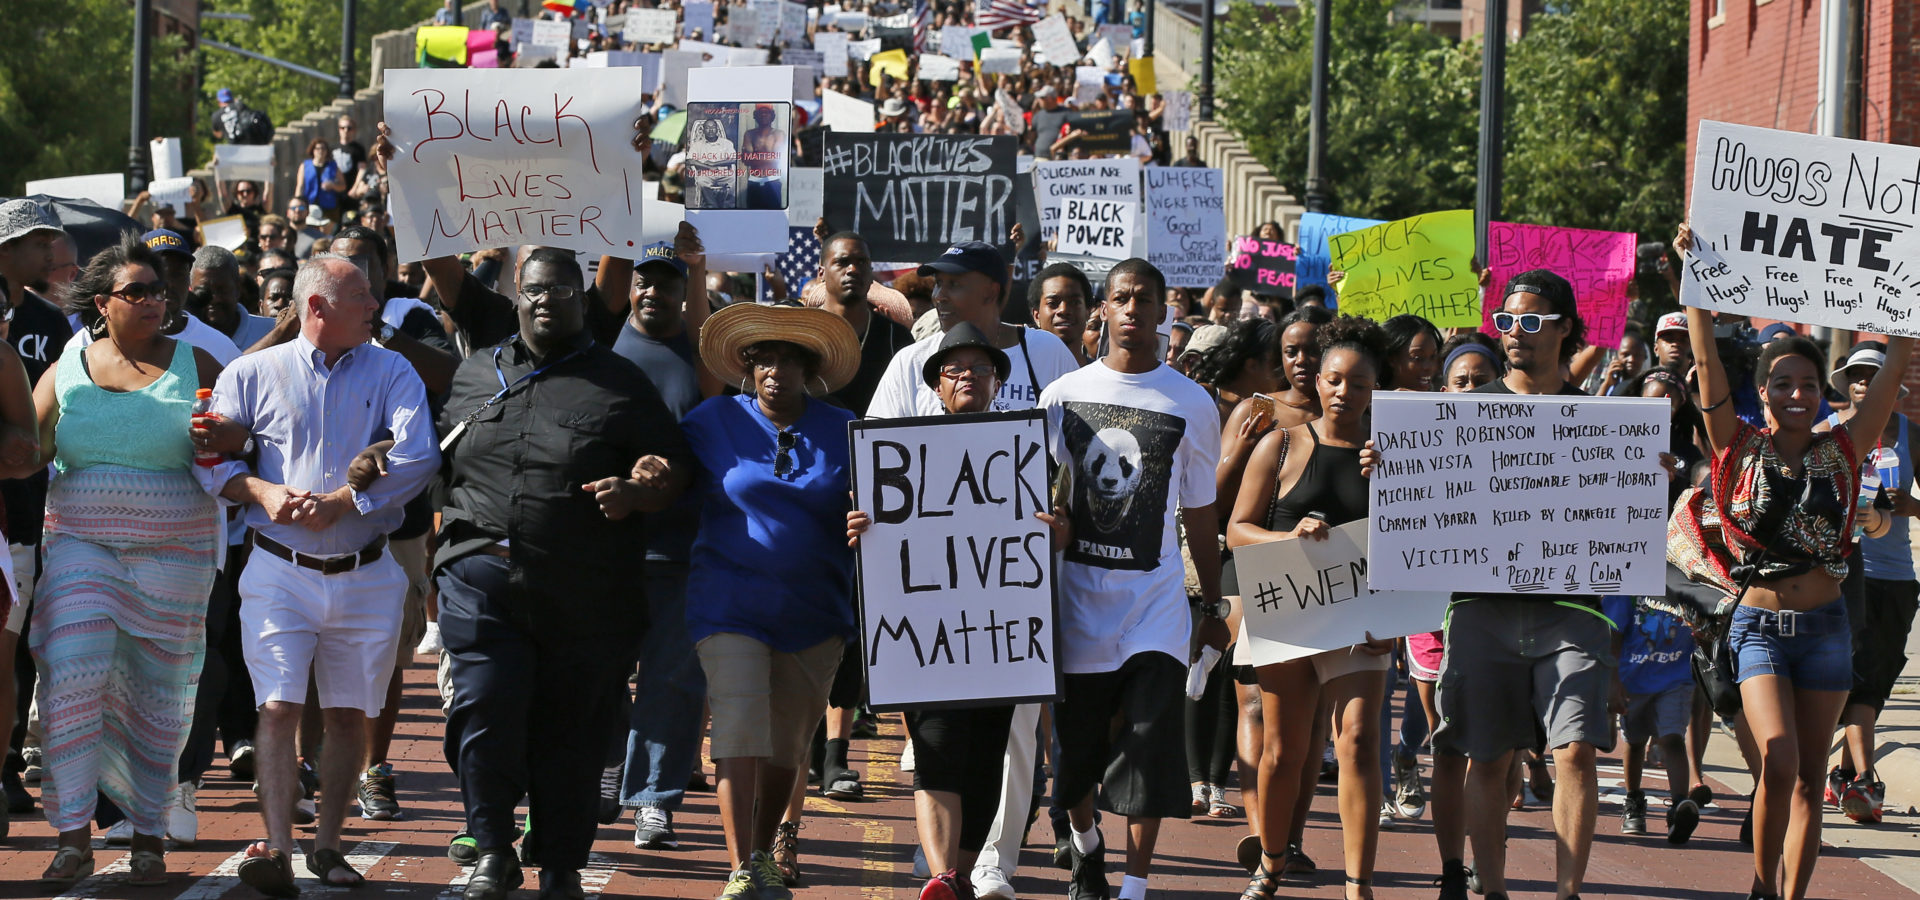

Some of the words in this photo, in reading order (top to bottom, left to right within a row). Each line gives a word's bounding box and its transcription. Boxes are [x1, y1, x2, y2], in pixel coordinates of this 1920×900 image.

[412, 89, 600, 174] BLACK
[692, 152, 717, 160] BLACK
[720, 152, 741, 160] LIVES
[688, 169, 734, 177] MURDERED
[1148, 169, 1215, 189] WHERE
[1050, 183, 1085, 196] GUNS
[1091, 184, 1107, 195] IN
[1112, 183, 1133, 195] THE
[1149, 194, 1188, 209] WERE
[1192, 195, 1223, 210] THOSE
[853, 174, 1013, 245] MATTER
[1068, 200, 1125, 223] BLACK
[1066, 224, 1125, 247] POWER
[1740, 211, 1893, 272] HATE
[1690, 259, 1732, 282] Free
[1765, 266, 1799, 282] Free
[1825, 269, 1853, 287] Free
[1873, 276, 1901, 298] Free
[1706, 275, 1754, 304] Hugs!
[1765, 286, 1809, 313] Hugs!
[1824, 290, 1863, 314] Hugs!
[1877, 296, 1912, 322] Hugs!
[1435, 402, 1456, 421] IN
[1477, 402, 1535, 420] MEMORY
[1561, 403, 1579, 418] OF
[1378, 429, 1444, 452] DARIUS
[1456, 425, 1535, 447] ROBINSON
[1429, 454, 1473, 471] VISTA
[1492, 450, 1556, 472] HOMICIDE
[1572, 446, 1615, 463] CUSTER
[872, 435, 1046, 524] BLACK
[1378, 485, 1435, 507] MICHAEL
[1446, 481, 1477, 500] HALL
[1490, 474, 1571, 493] QUESTIONABLE
[1379, 515, 1427, 533] CARMEN
[1434, 511, 1477, 529] YBARRA
[1493, 509, 1531, 526] KILLED
[1541, 508, 1555, 523] BY
[1564, 507, 1617, 522] CARNEGIE
[1627, 505, 1663, 524] POLICE
[1078, 539, 1134, 559] PANDA
[1402, 547, 1489, 570] VICTIMS
[1508, 542, 1524, 561] of
[1542, 540, 1579, 559] POLICE
[1589, 540, 1648, 556] BRUTALITY
[900, 532, 1045, 594] LIVES
